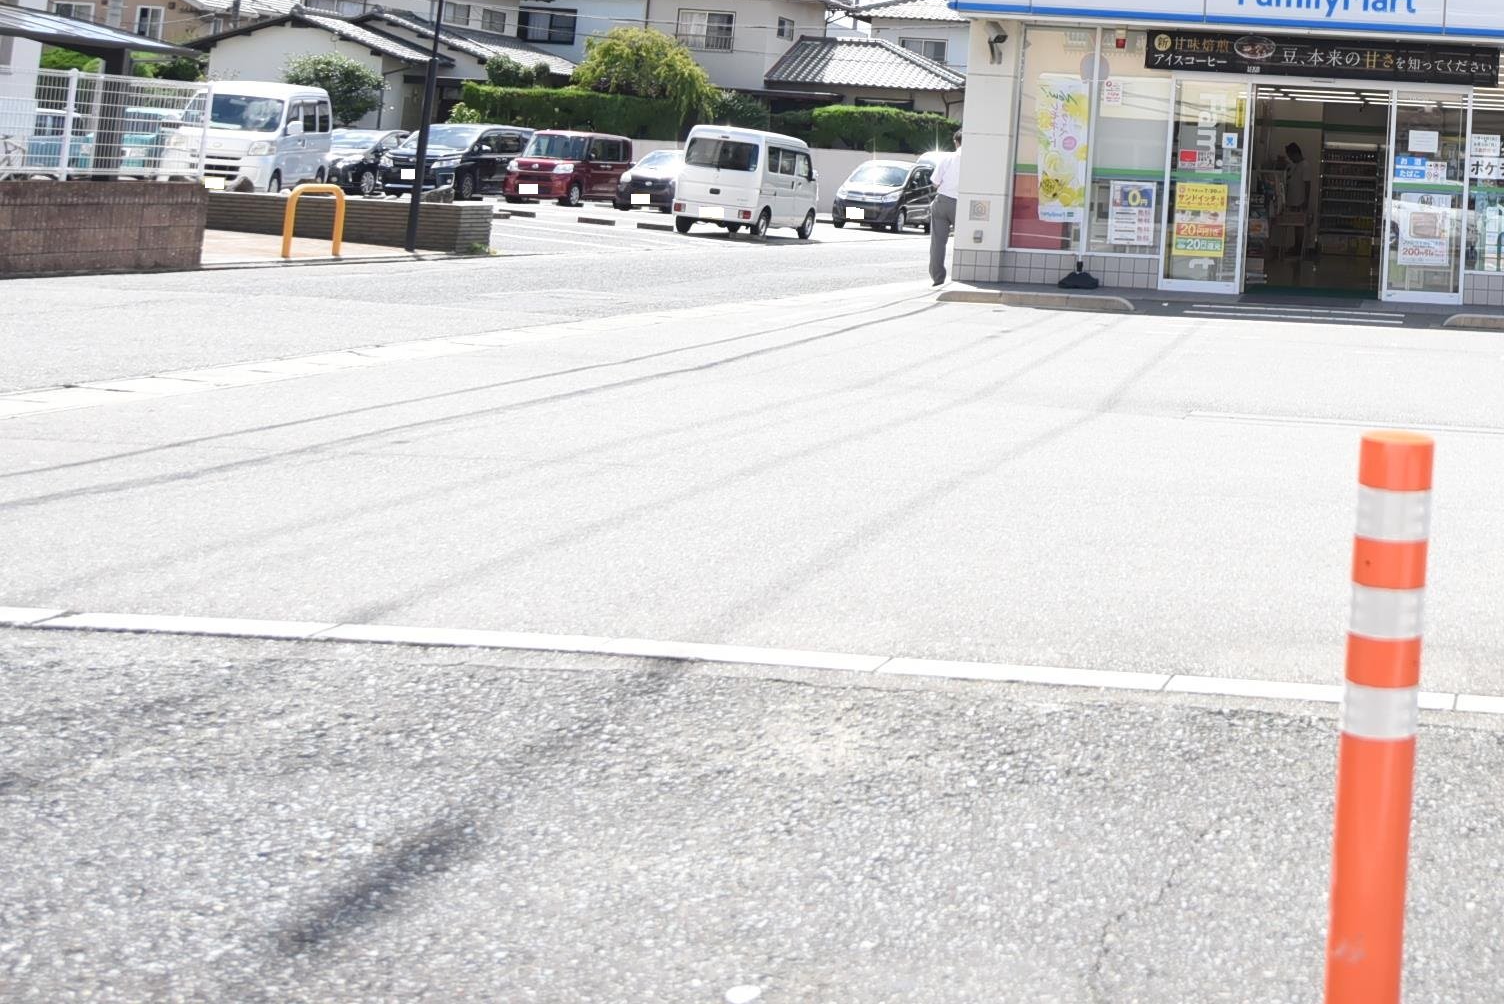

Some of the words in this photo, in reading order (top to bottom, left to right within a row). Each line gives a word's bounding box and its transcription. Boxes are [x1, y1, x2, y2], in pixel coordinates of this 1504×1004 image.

[1154, 53, 1227, 67] アイスコーヒー
